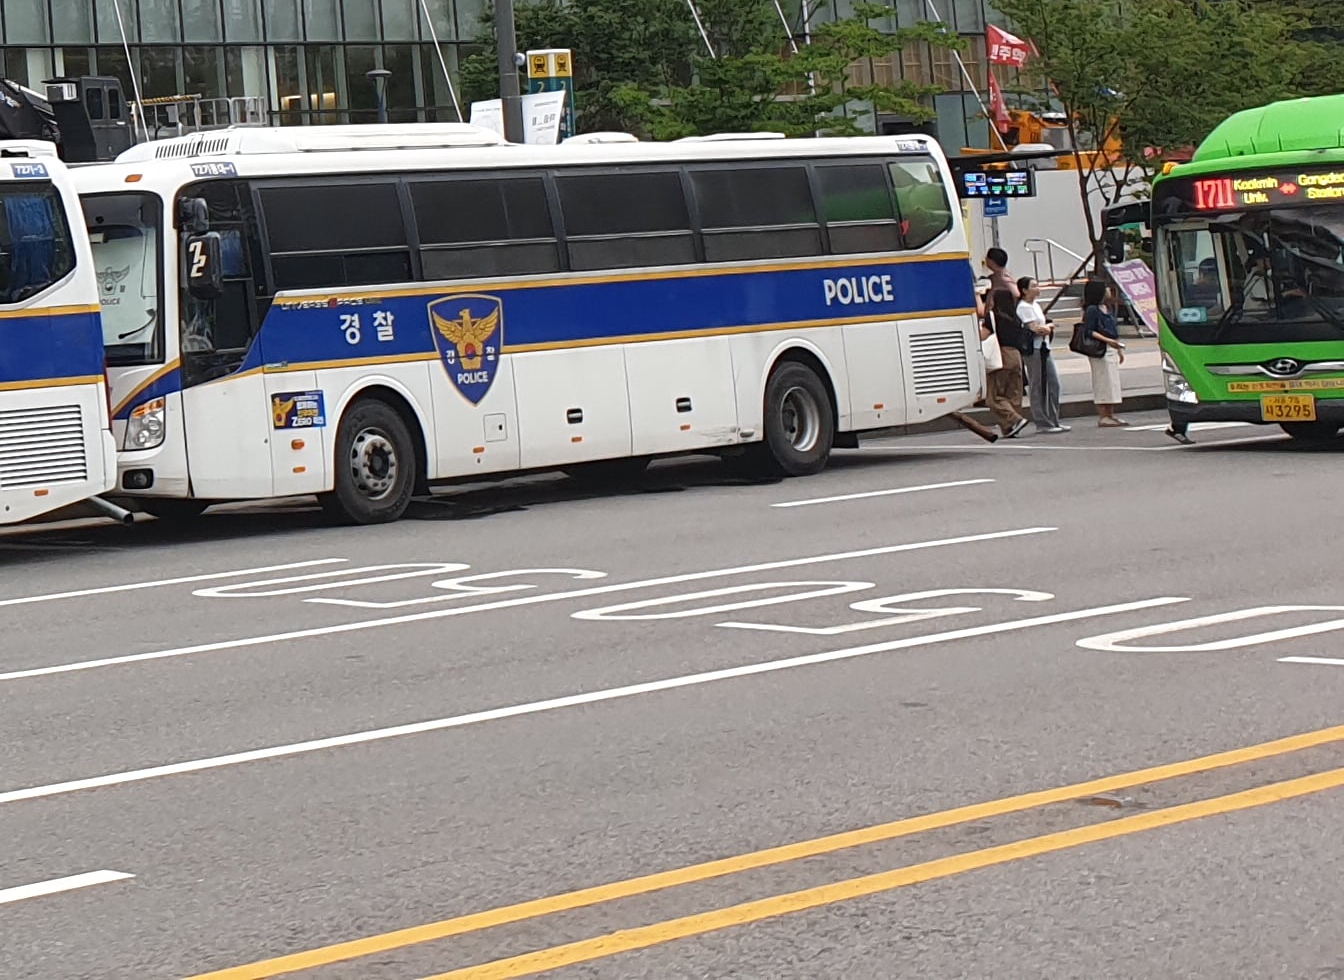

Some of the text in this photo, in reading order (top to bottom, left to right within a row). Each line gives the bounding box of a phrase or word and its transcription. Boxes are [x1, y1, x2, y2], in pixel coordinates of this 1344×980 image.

[1194, 179, 1235, 209] 1711
[823, 275, 894, 306] POLICE
[457, 371, 488, 384] POLICE
